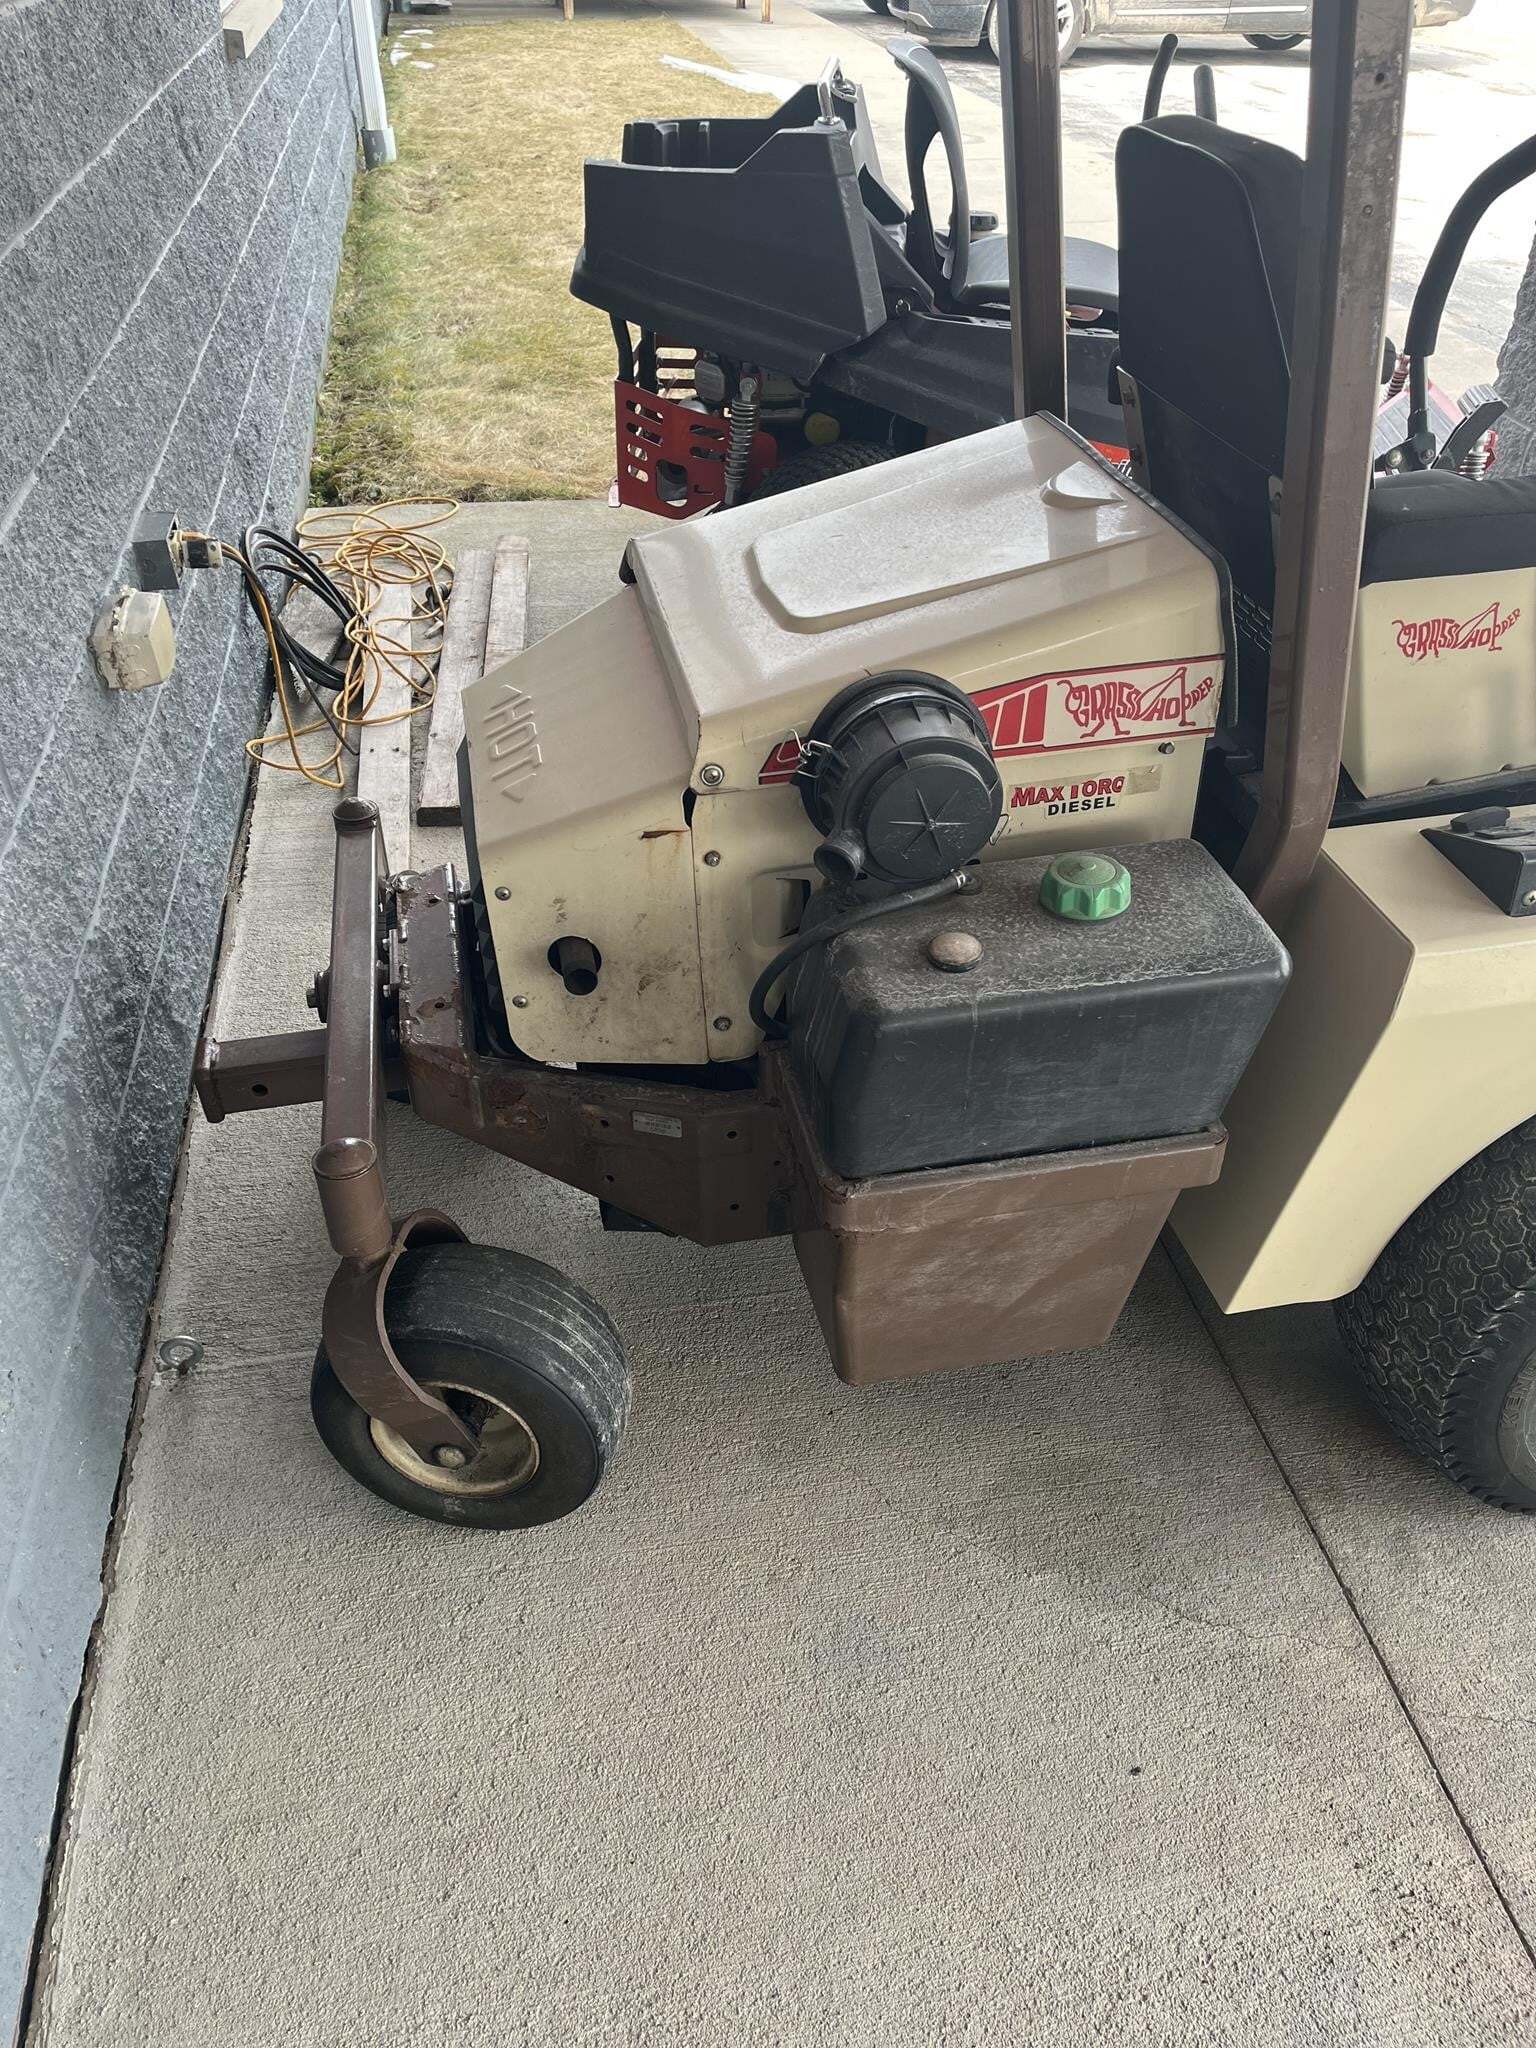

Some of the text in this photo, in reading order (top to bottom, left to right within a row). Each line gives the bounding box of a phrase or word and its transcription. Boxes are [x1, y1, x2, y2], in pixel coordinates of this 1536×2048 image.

[1057, 667, 1214, 738] GRASSHOPPER
[483, 695, 542, 782] HOT
[1048, 796, 1115, 816] DIESEL
